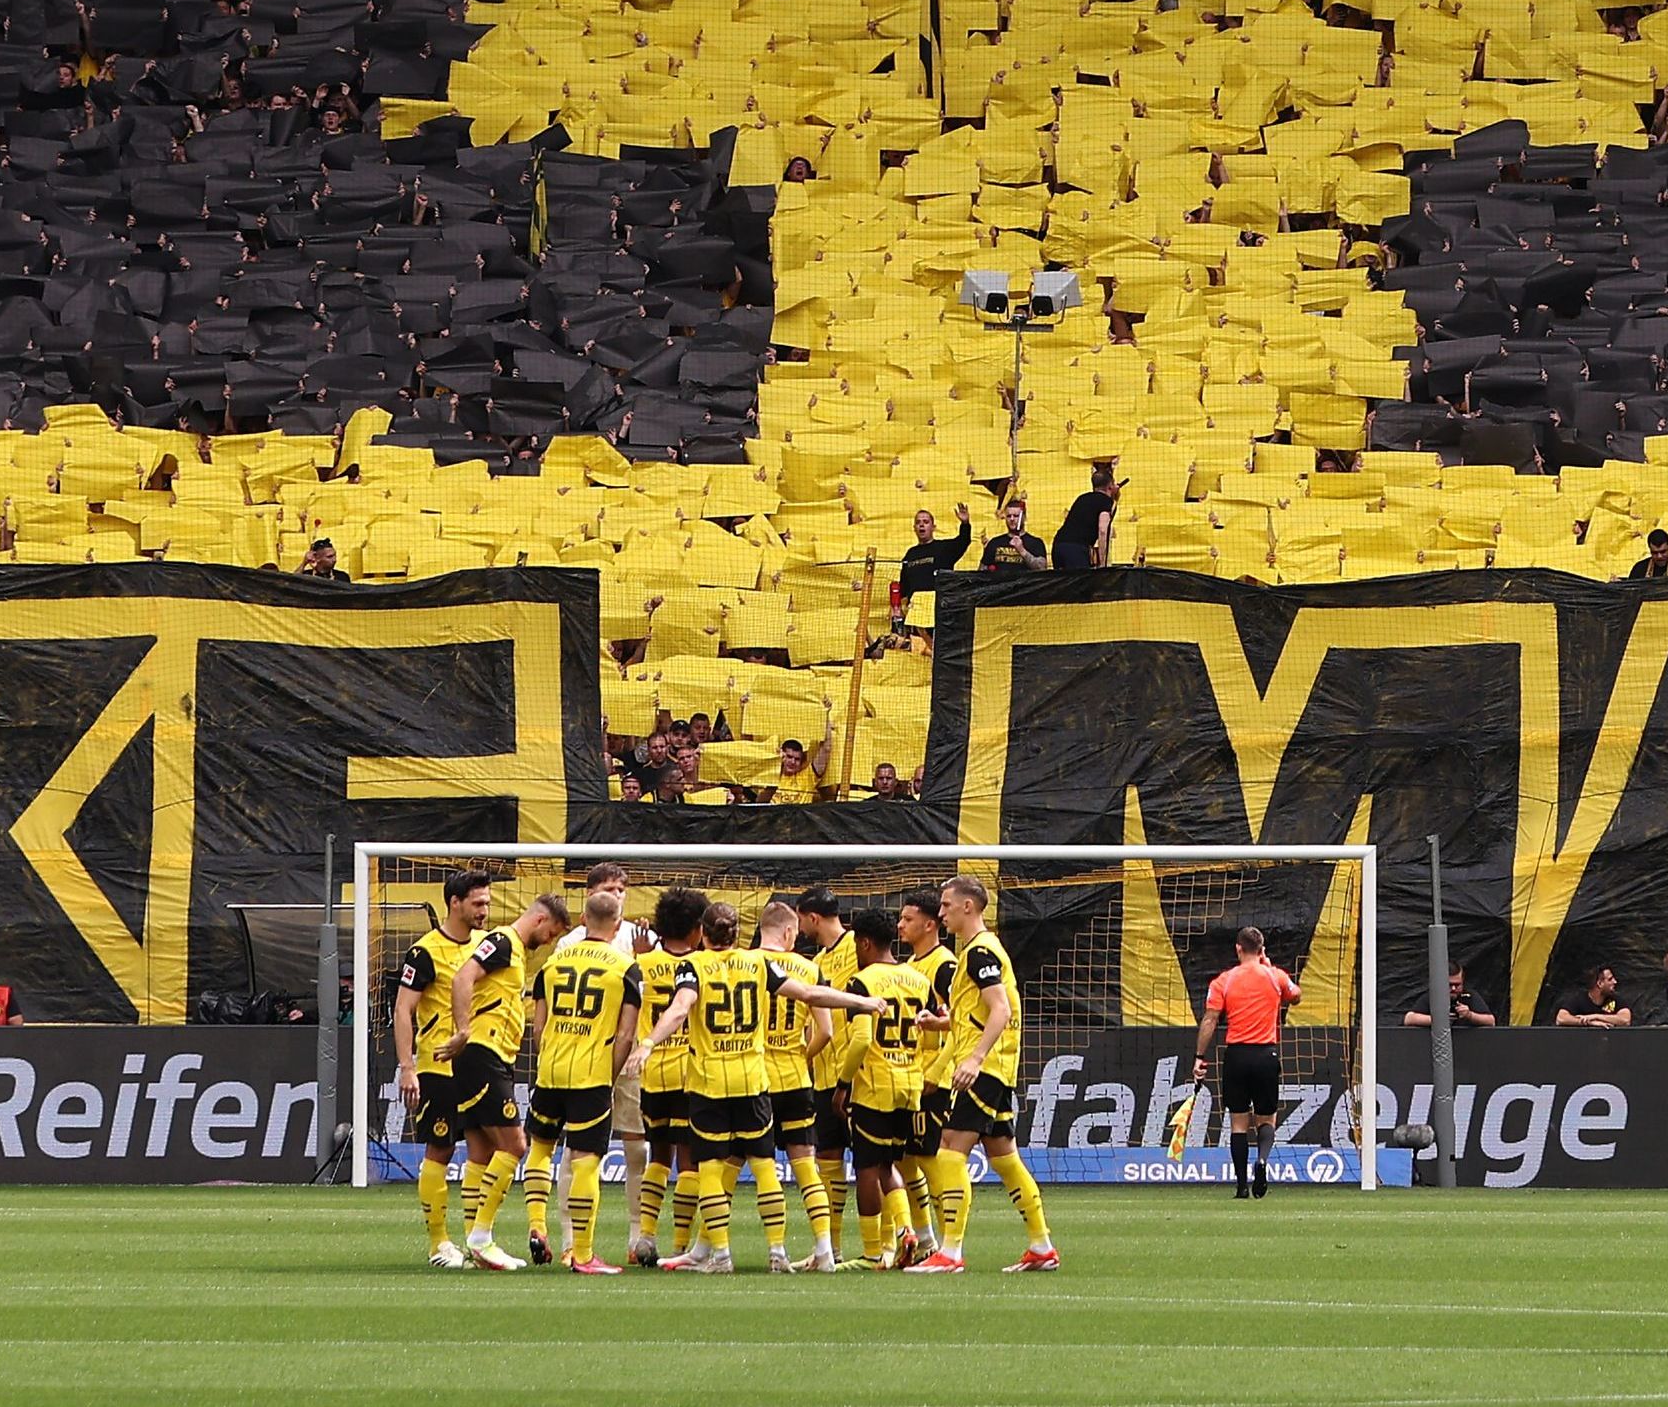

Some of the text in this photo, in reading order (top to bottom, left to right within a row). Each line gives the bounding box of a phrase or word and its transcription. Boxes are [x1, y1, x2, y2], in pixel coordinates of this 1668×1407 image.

[556, 948, 618, 966] DORTMUND
[552, 966, 608, 1019] 26
[705, 980, 759, 1034] 20
[553, 1020, 593, 1037] RYERSON
[1123, 1161, 1299, 1182] SIGNAL INA
